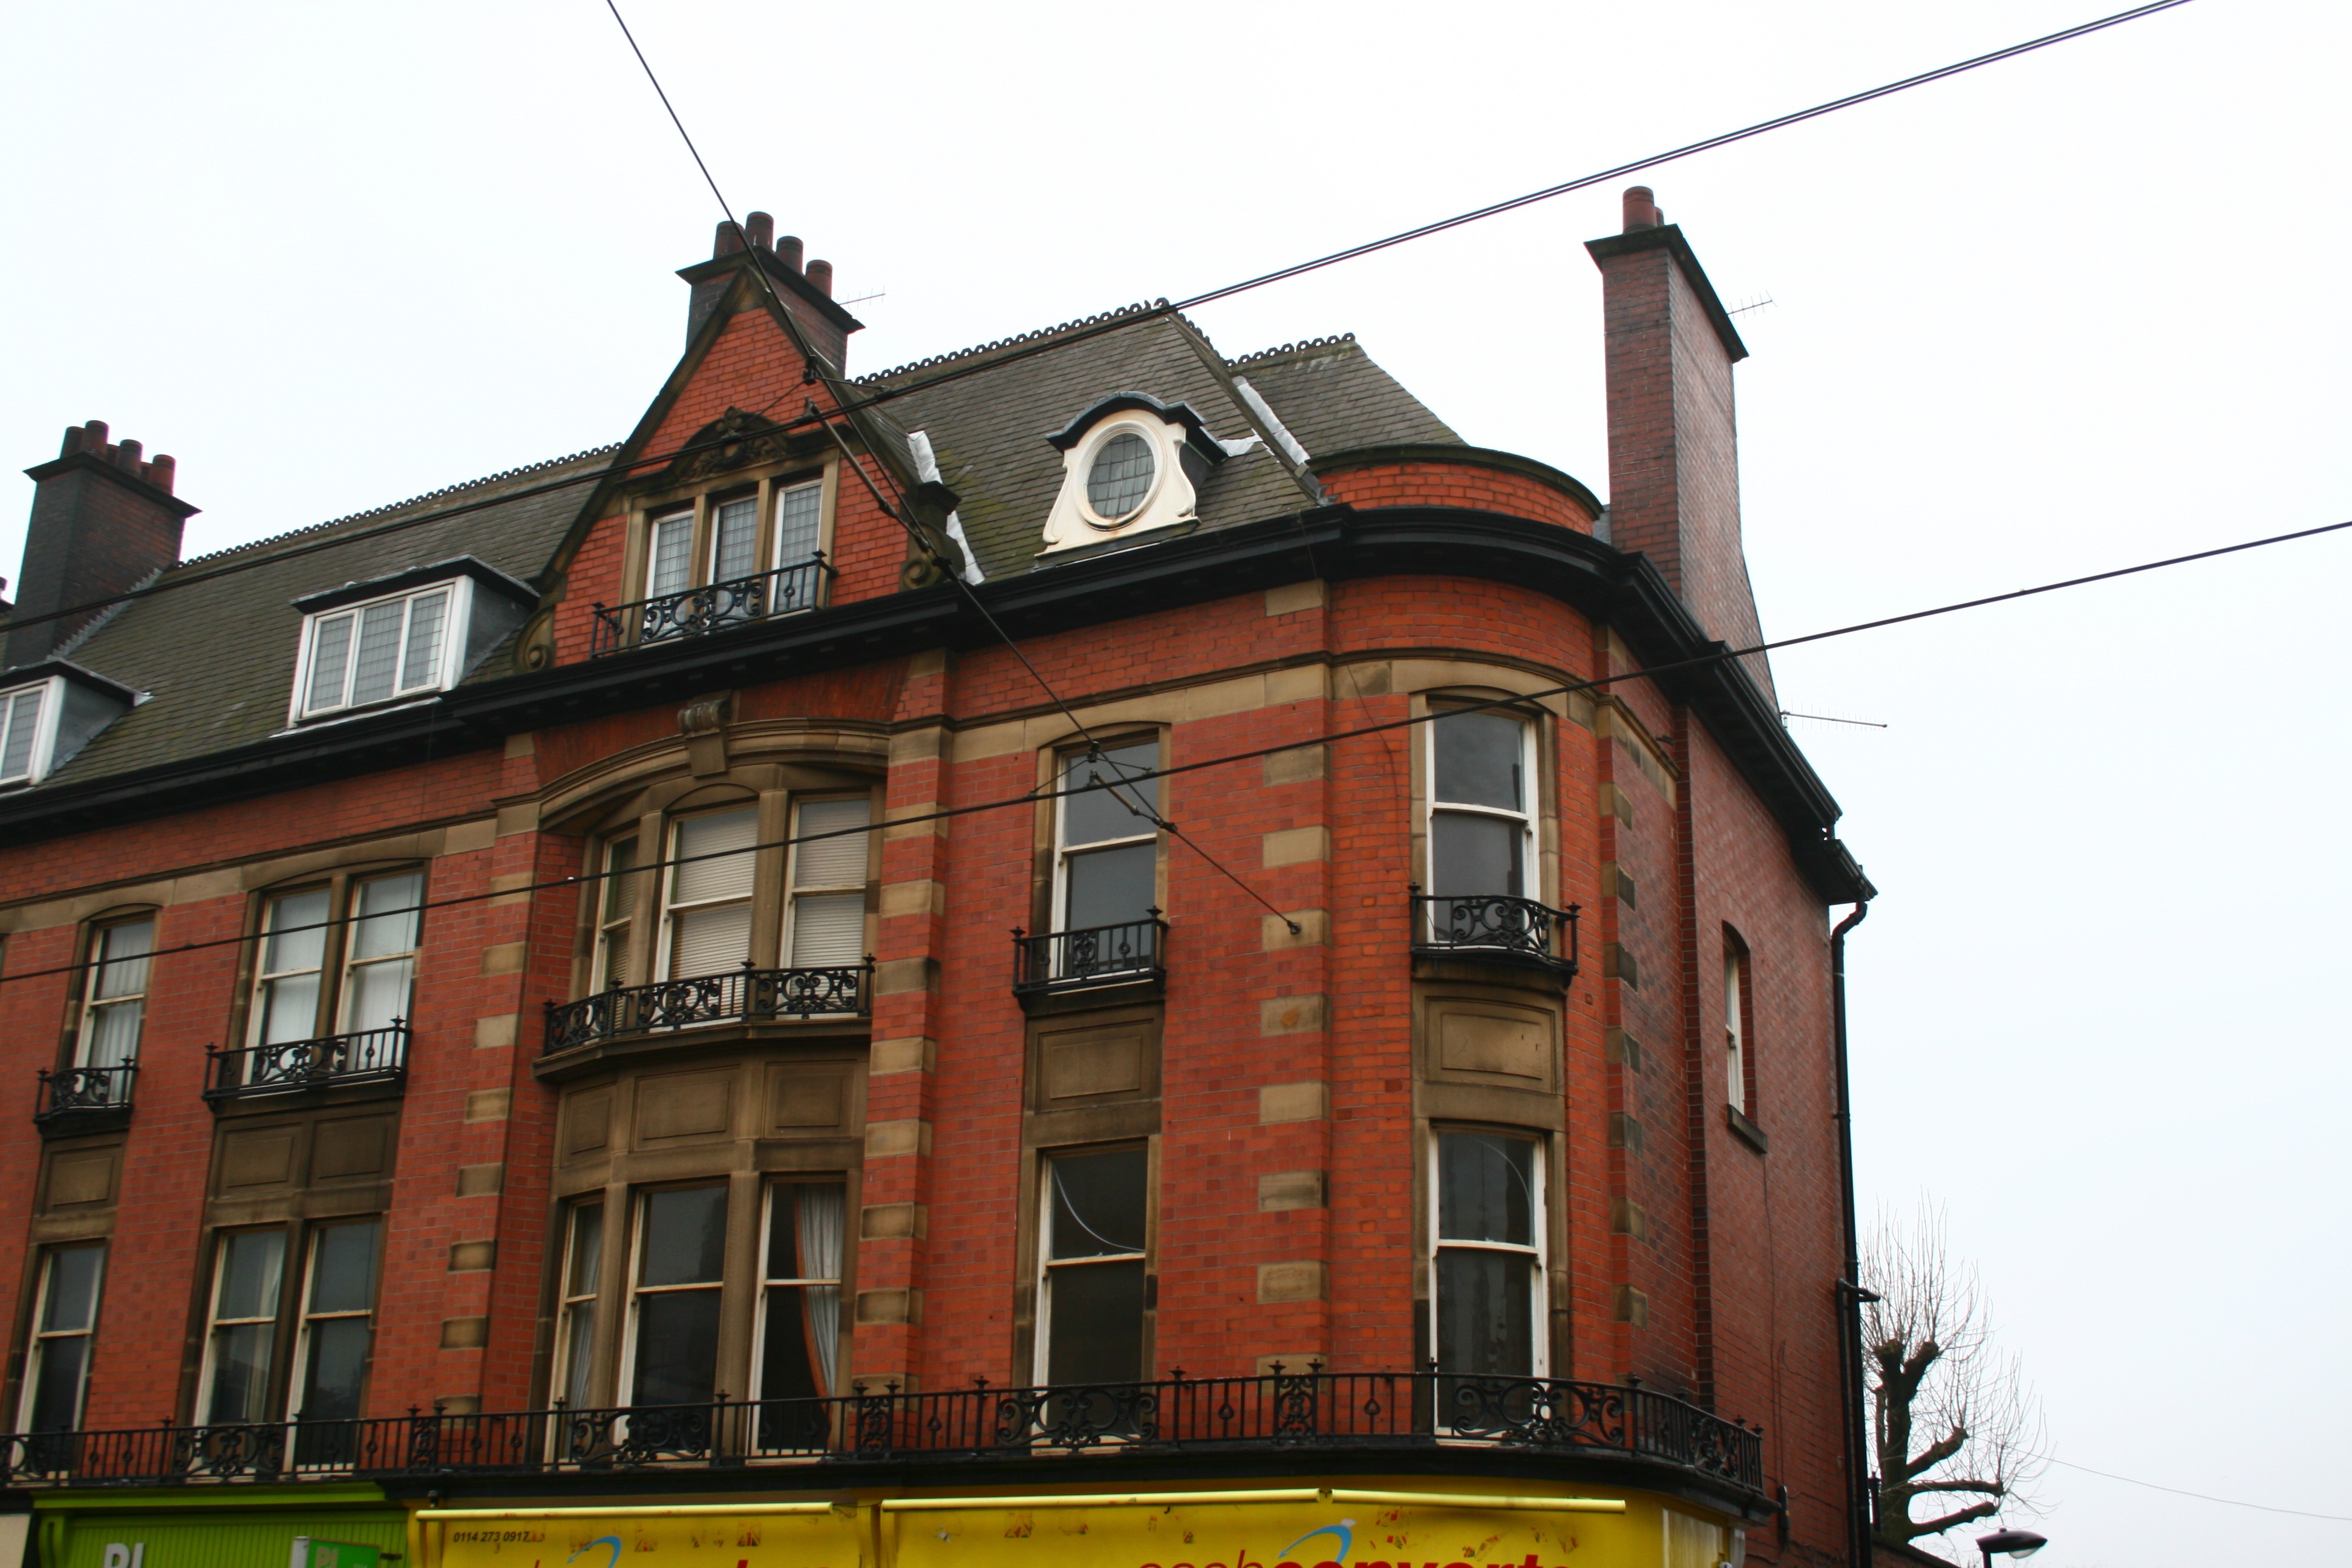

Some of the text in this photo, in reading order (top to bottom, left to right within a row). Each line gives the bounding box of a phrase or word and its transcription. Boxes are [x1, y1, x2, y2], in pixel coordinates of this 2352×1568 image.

[453, 1531, 530, 1542] 0114 273 0917
